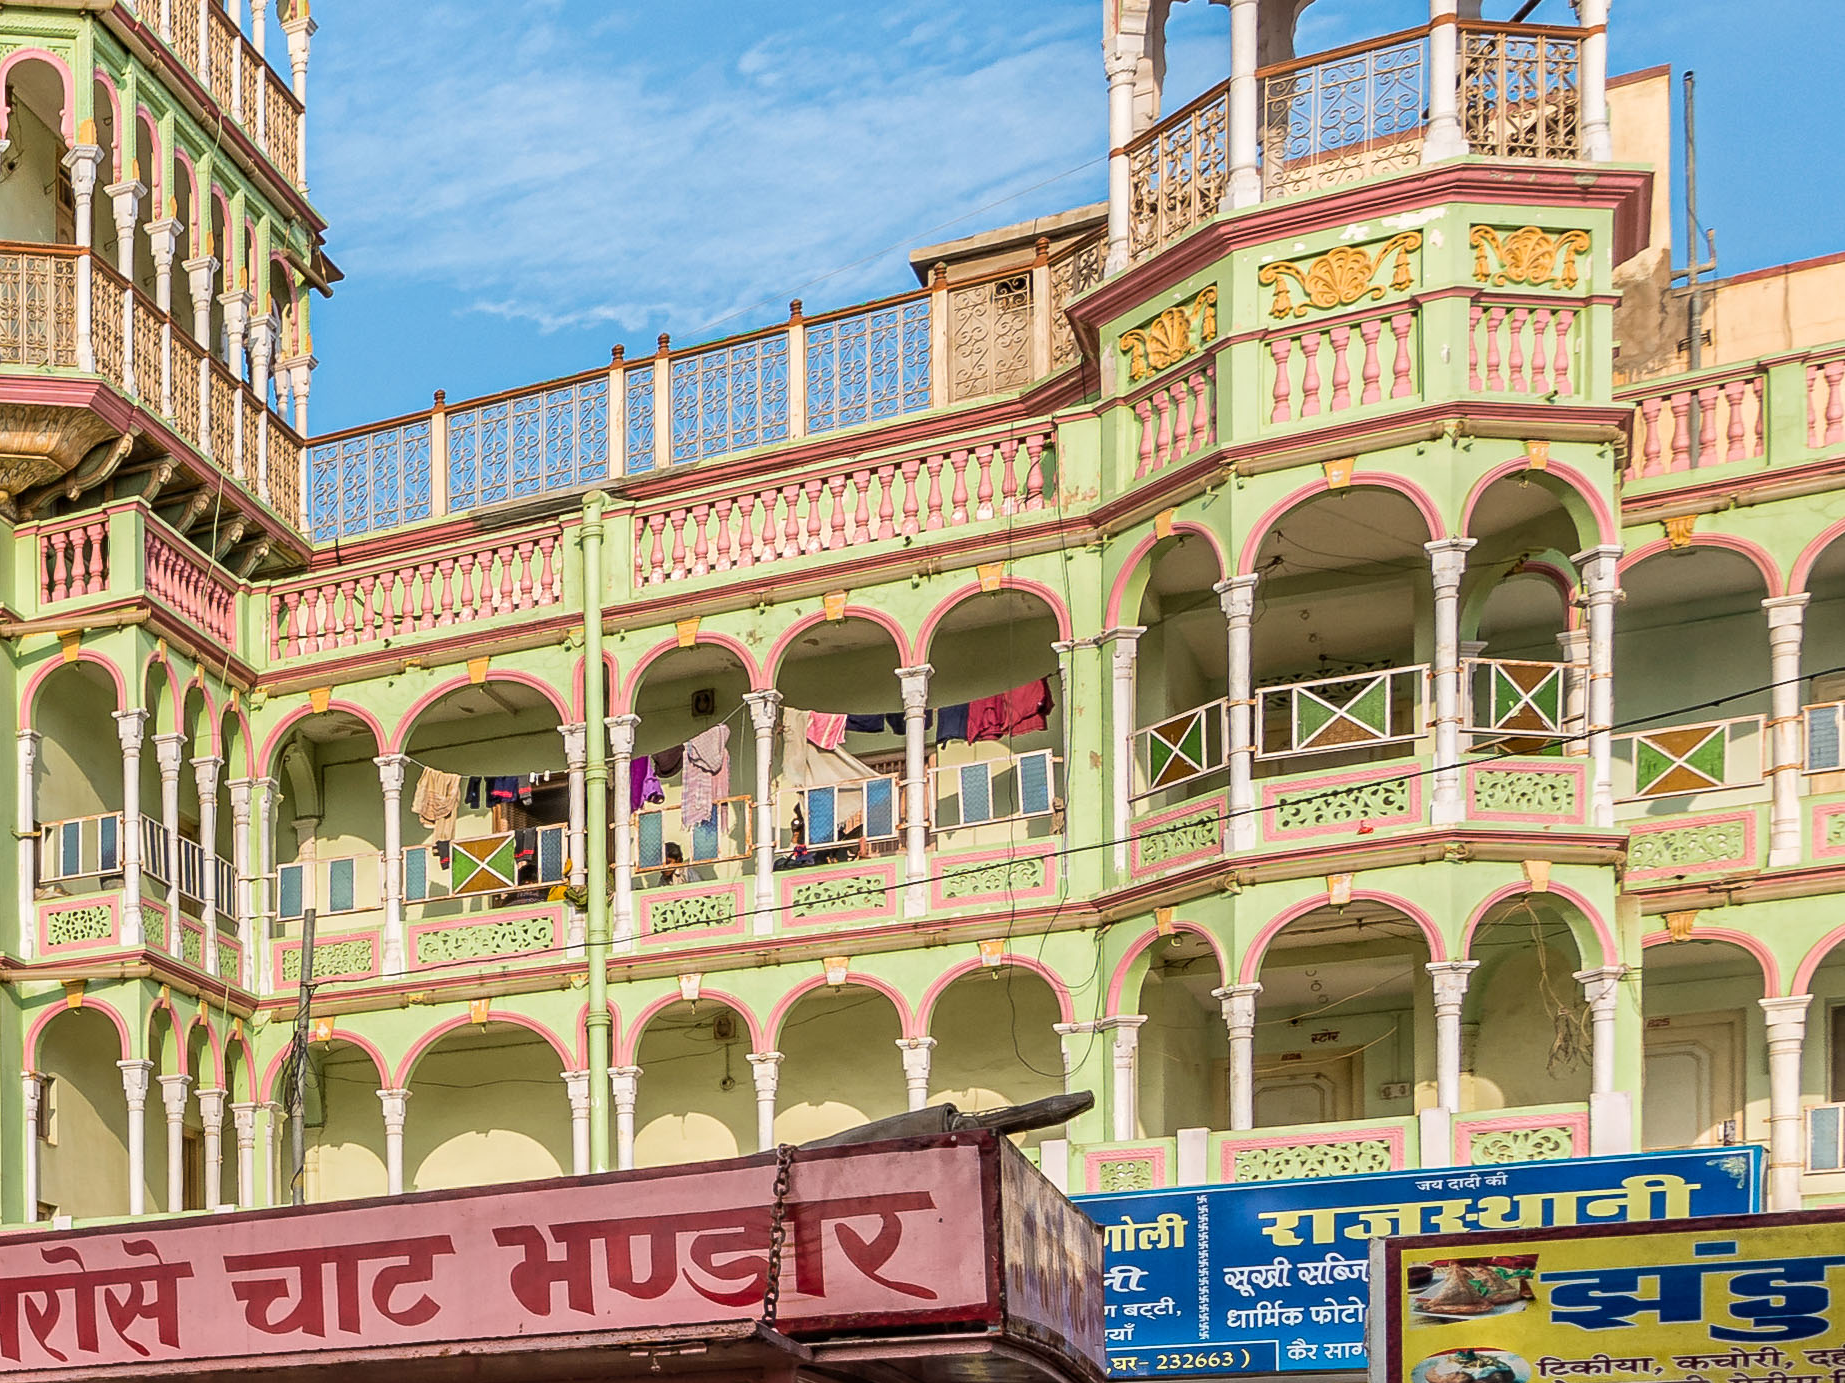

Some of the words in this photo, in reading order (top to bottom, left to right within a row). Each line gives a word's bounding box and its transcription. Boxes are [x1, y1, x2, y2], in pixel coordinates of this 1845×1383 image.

[1416, 1180, 1444, 1192] जय
[1447, 1176, 1482, 1190] दादी
[1485, 1174, 1508, 1187] की
[1258, 1174, 1702, 1247] राजस्थानी
[224, 1234, 456, 1339] चाट
[493, 1190, 938, 1319] भण्डार
[1224, 1257, 1292, 1296] सूखी
[1298, 1253, 1368, 1285] सब्जि
[1227, 1300, 1303, 1329] धार्मिक
[1156, 1351, 1235, 1370] 232663
[1673, 1347, 1795, 1371] कचोरी,
